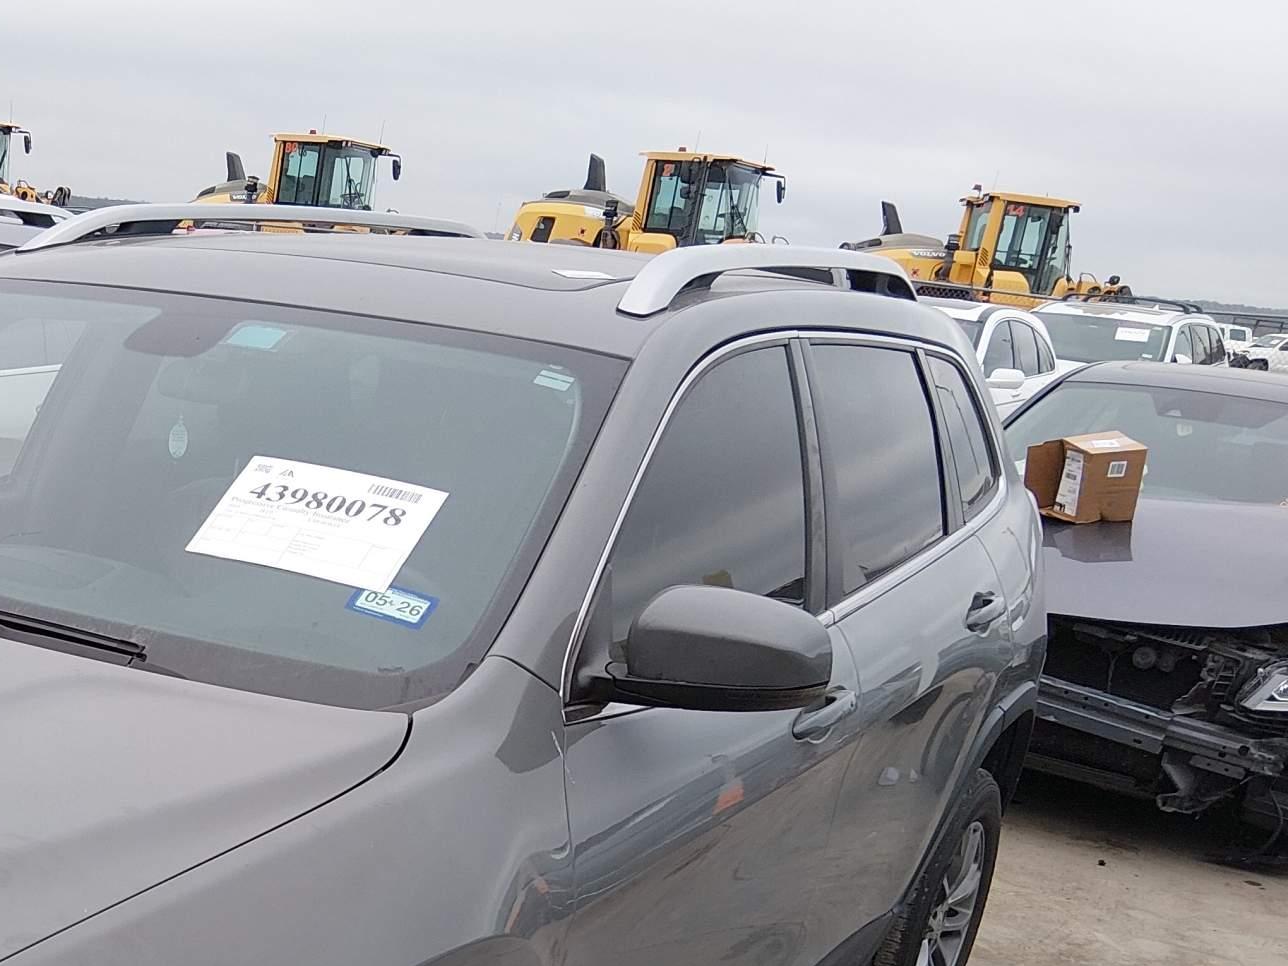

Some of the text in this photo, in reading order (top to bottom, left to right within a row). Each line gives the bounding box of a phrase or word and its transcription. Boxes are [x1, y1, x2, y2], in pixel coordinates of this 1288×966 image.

[248, 482, 407, 527] 43980078
[364, 591, 423, 617] 05 26
